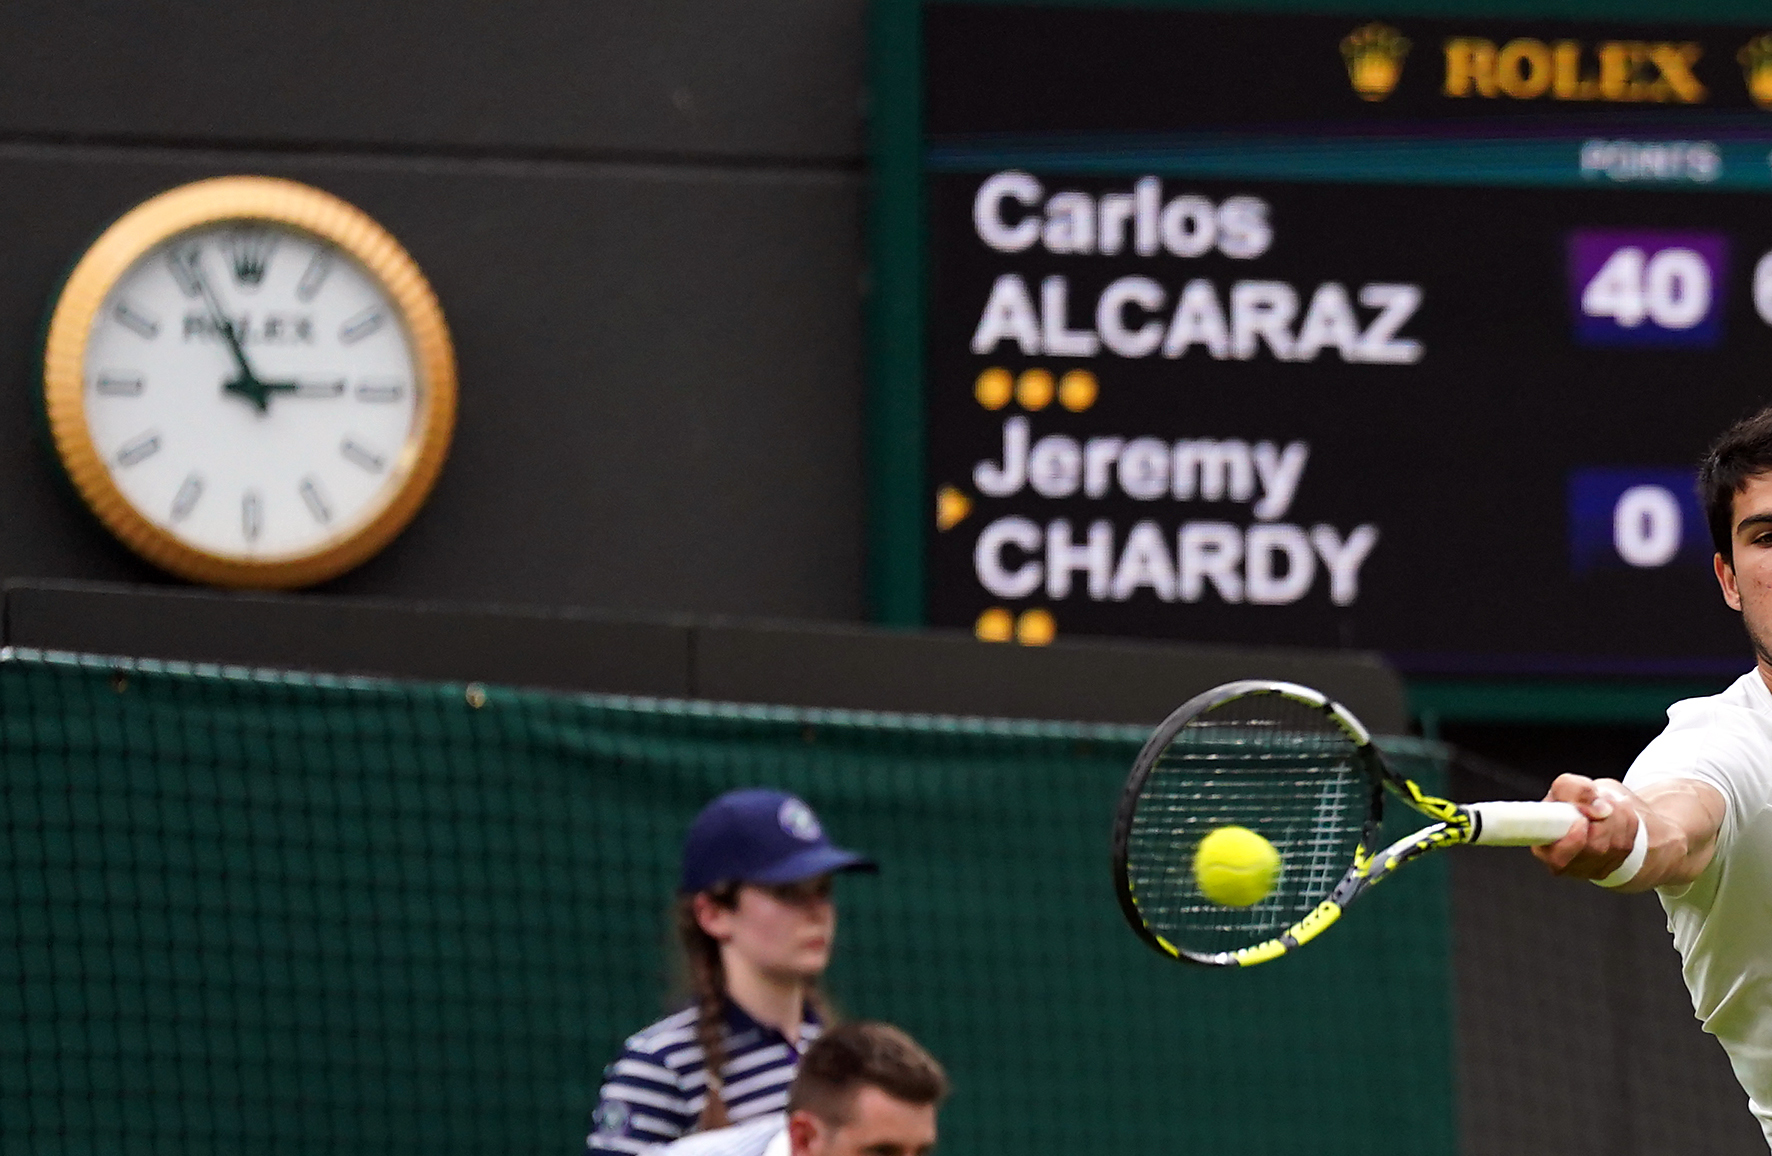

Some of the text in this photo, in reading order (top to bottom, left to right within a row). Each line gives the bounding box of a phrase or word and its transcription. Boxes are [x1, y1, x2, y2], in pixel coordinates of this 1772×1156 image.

[1443, 37, 1704, 103] ROLEX
[1580, 139, 1722, 183] POINTS
[972, 171, 1273, 260] Carlos
[971, 273, 1424, 364] ALCARAZ
[1581, 247, 1711, 329] 40
[973, 415, 1310, 521] Jeremy
[973, 515, 1379, 605] CHARDY
[1612, 484, 1682, 568] 0
